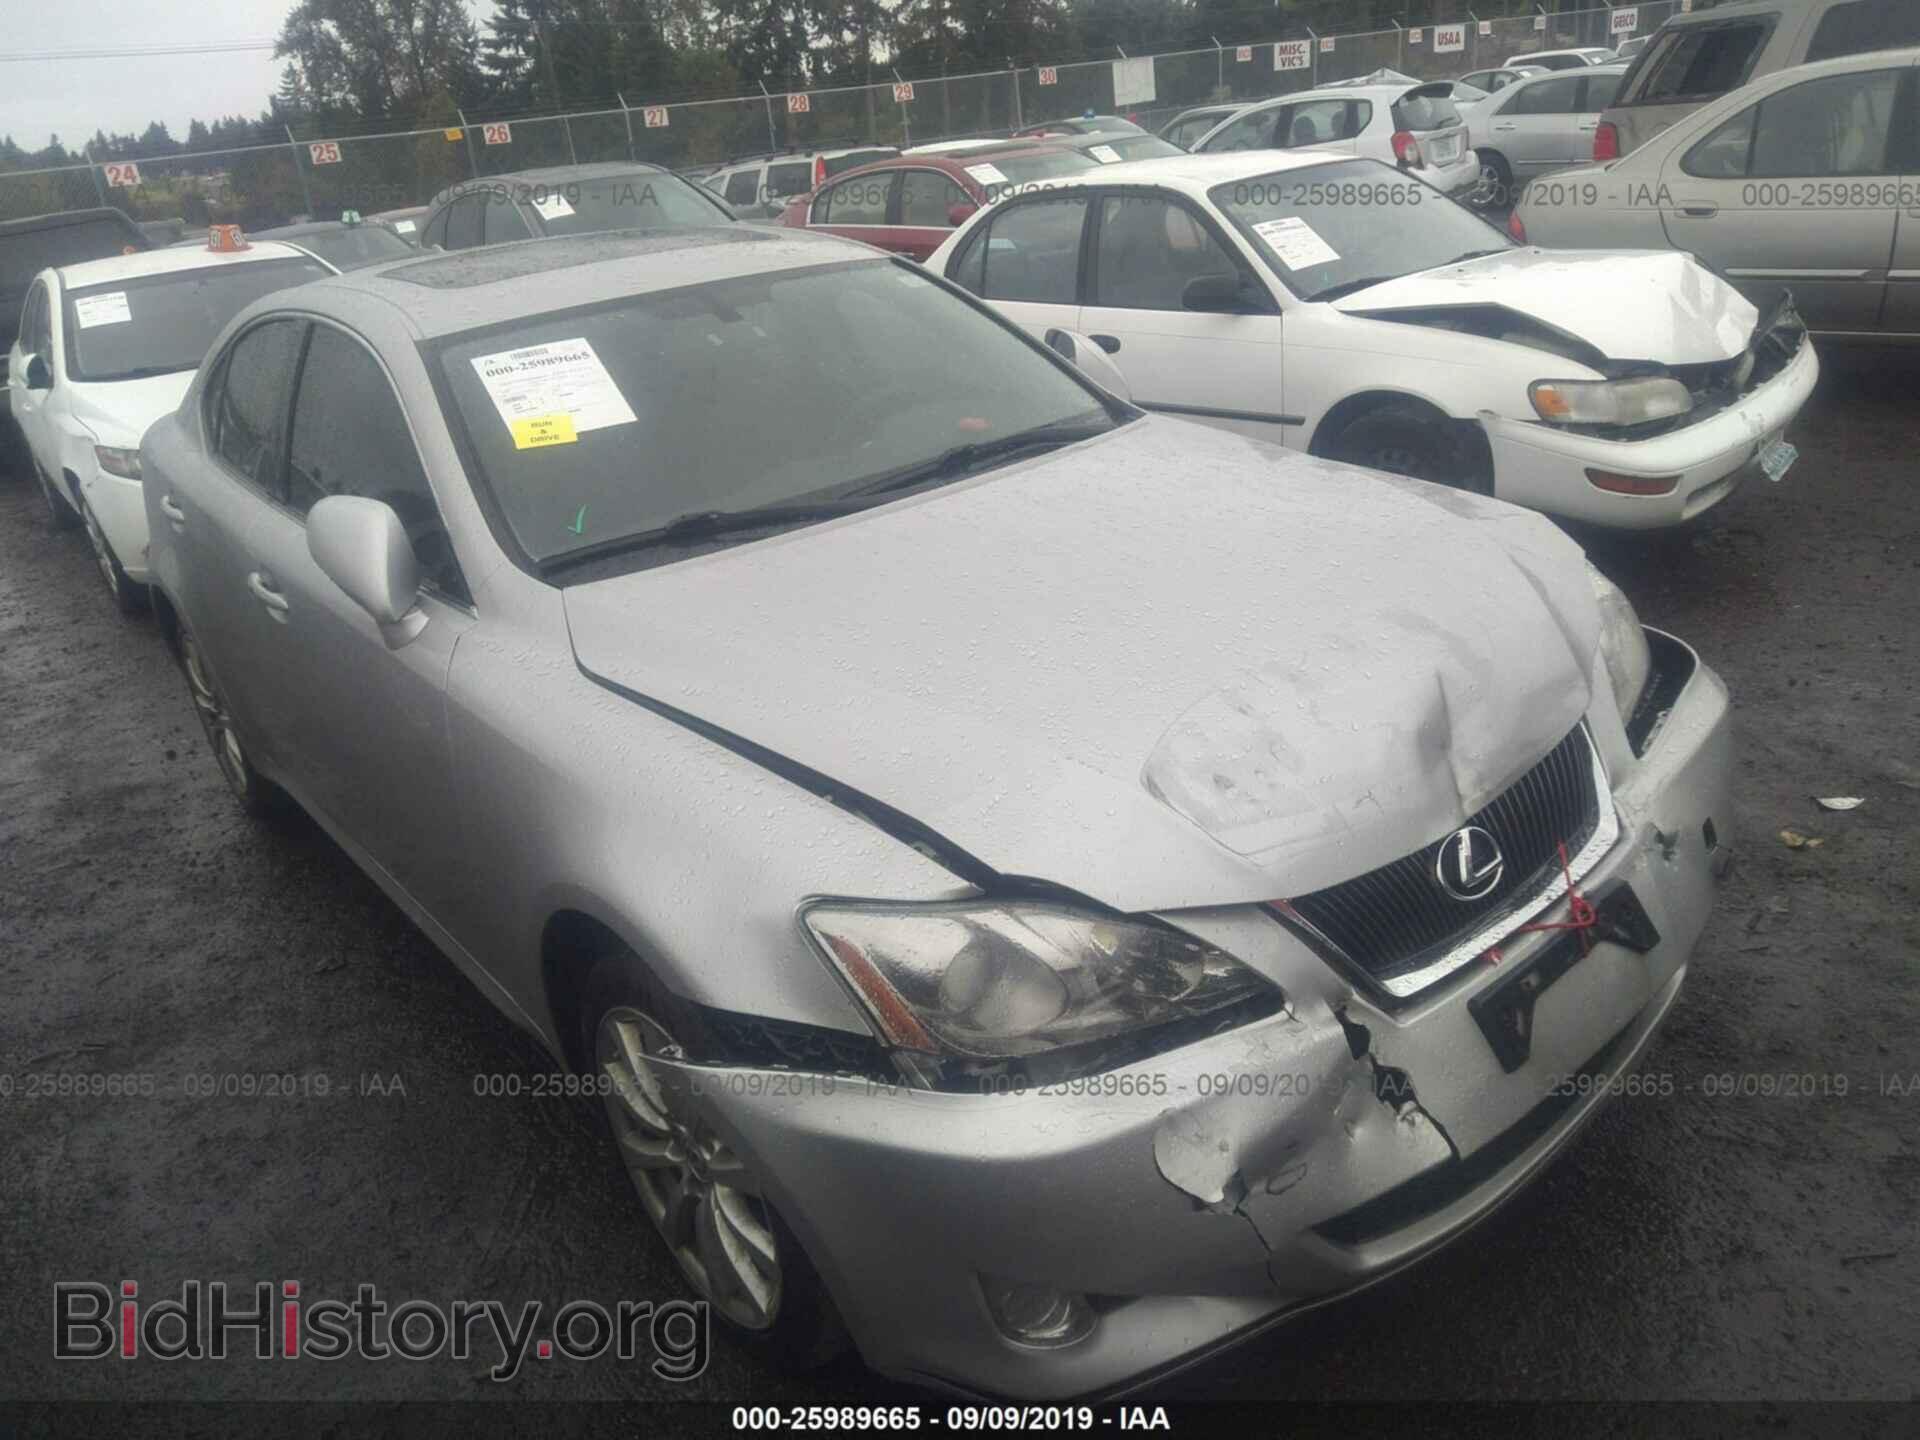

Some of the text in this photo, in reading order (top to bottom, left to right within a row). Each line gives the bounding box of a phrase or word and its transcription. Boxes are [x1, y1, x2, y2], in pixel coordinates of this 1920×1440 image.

[1614, 13, 1635, 28] GEICO
[1438, 31, 1461, 46] USAA
[1279, 43, 1306, 55] MISC.
[1039, 67, 1056, 83] 30
[895, 84, 912, 99] 29
[790, 95, 807, 112] 28
[647, 109, 665, 126] 27
[486, 122, 509, 143] 26
[315, 144, 338, 163] 25
[107, 166, 137, 185] 24
[486, 351, 591, 377] 000-25989665
